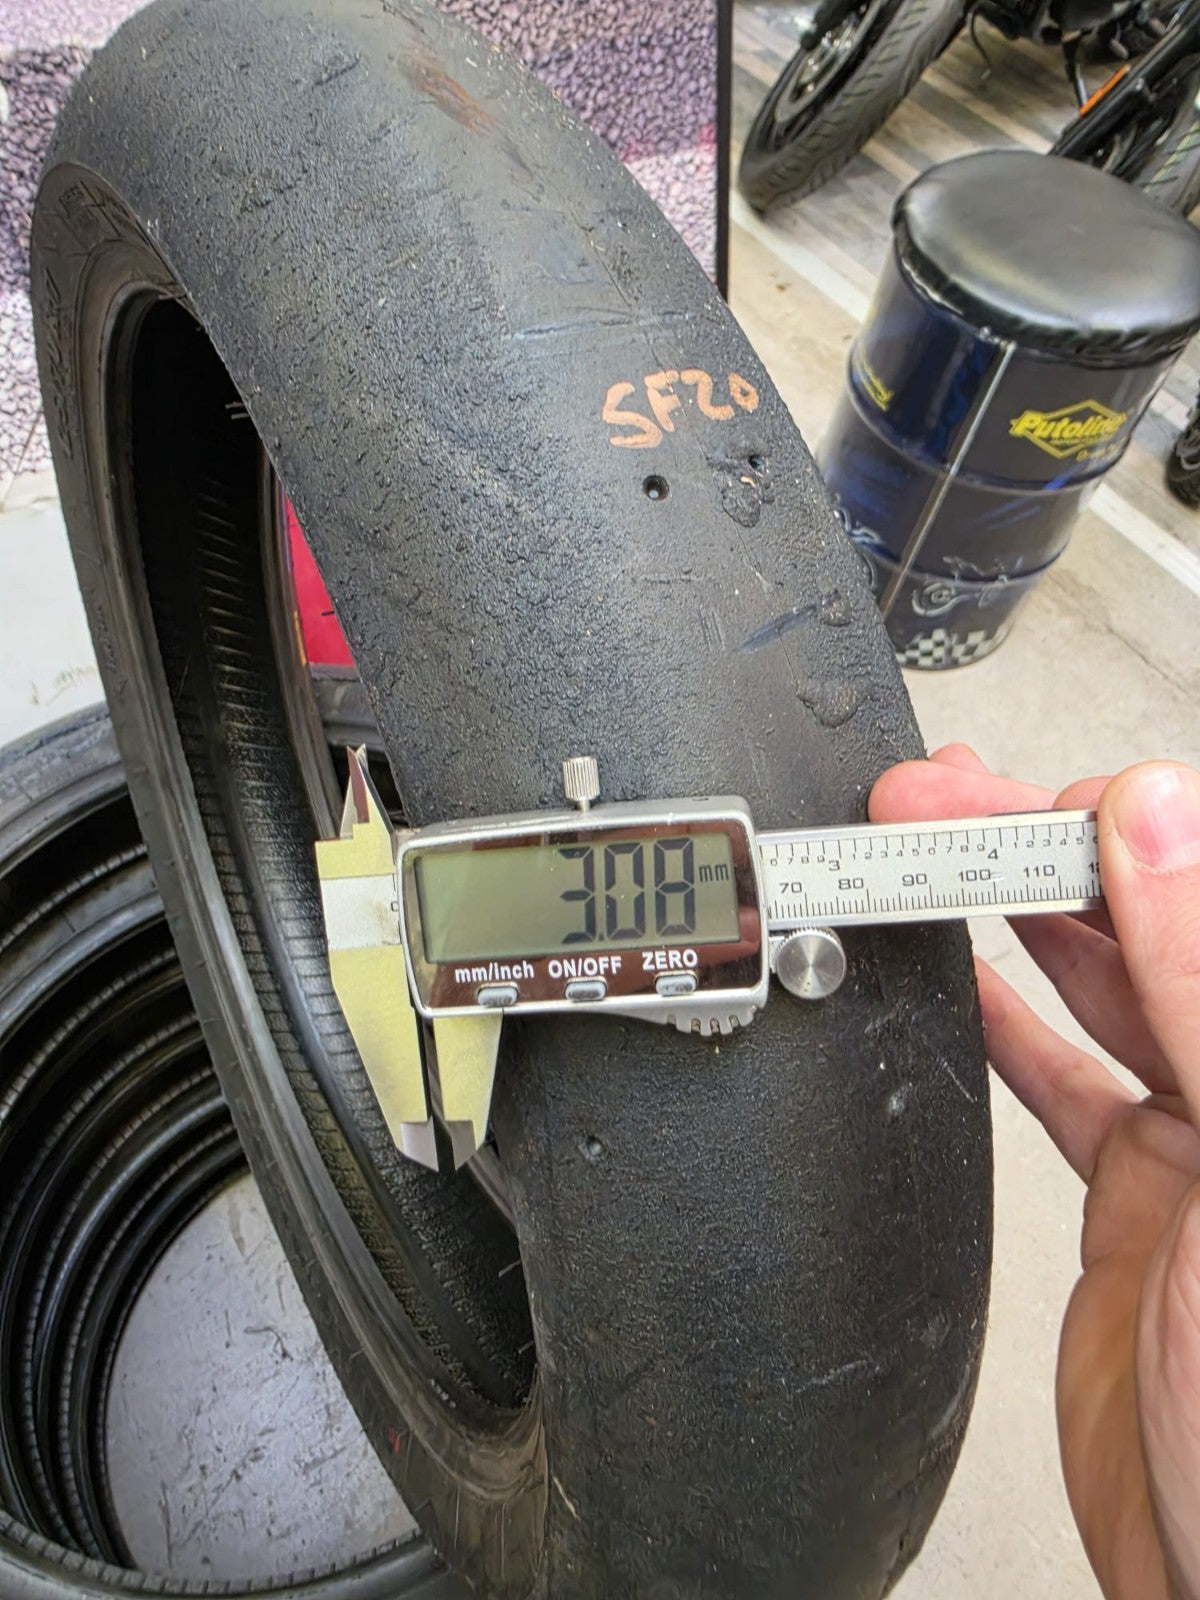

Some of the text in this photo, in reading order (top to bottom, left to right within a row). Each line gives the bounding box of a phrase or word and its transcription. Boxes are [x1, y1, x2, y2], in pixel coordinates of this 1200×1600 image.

[828, 860, 840, 871] 3
[960, 845, 969, 853] 8
[987, 848, 998, 860] 4
[699, 863, 729, 882] mm
[779, 864, 1055, 894] 70 80 90 100 110
[455, 949, 698, 984] mm/inch ON/OFF ZERO
